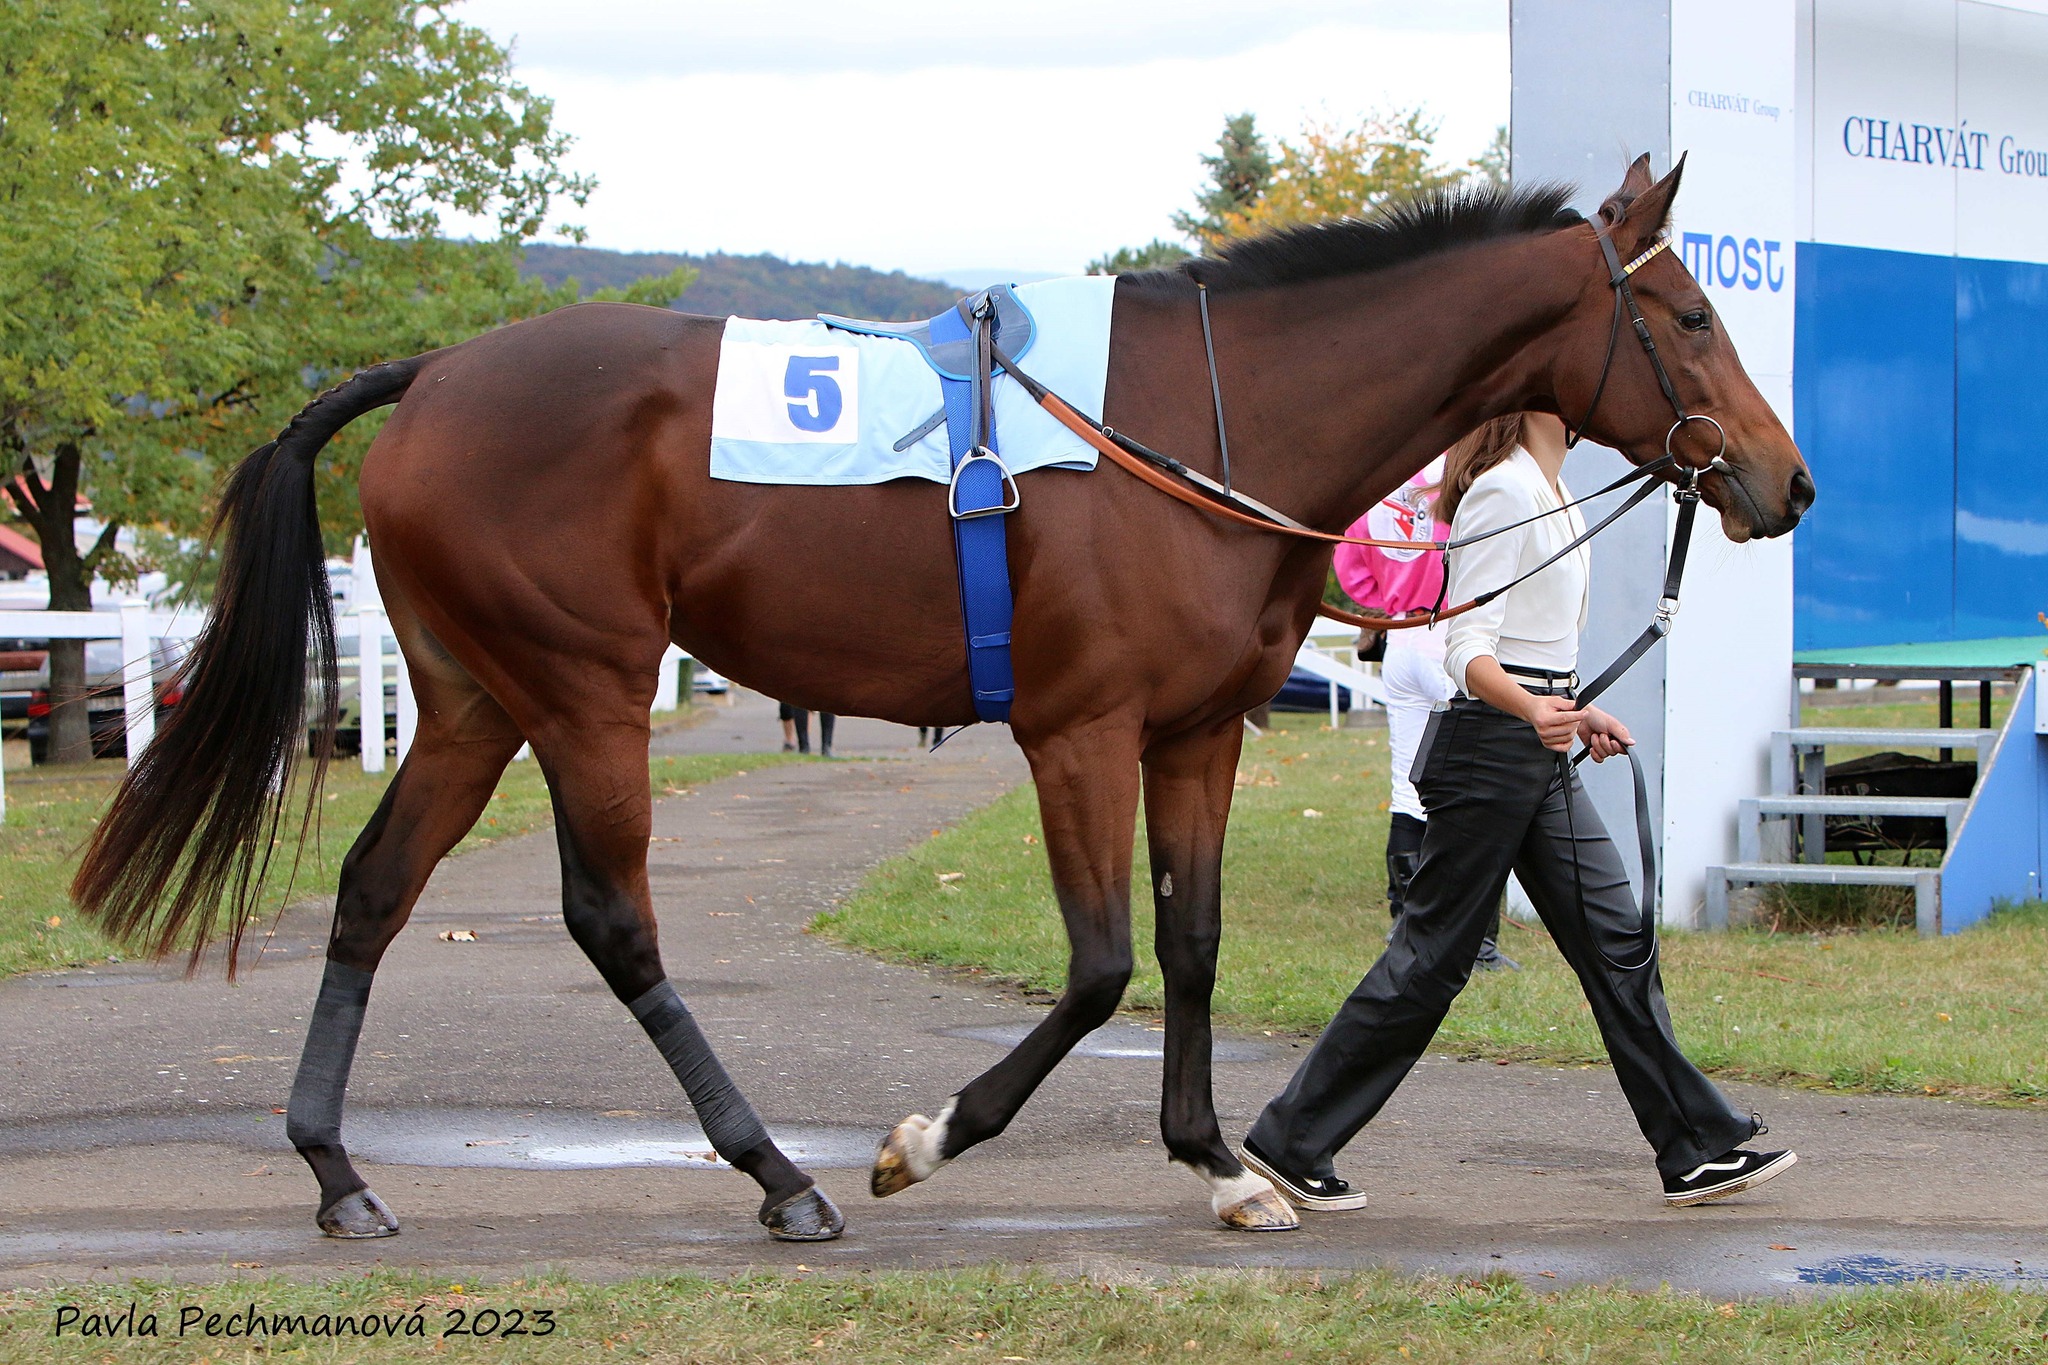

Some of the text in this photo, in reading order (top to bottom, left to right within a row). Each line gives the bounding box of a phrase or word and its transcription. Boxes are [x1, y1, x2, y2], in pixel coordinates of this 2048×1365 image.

[1688, 89, 1750, 114] CHARVÁT
[1843, 115, 1989, 171] CHARVÁT
[784, 355, 842, 432] 5
